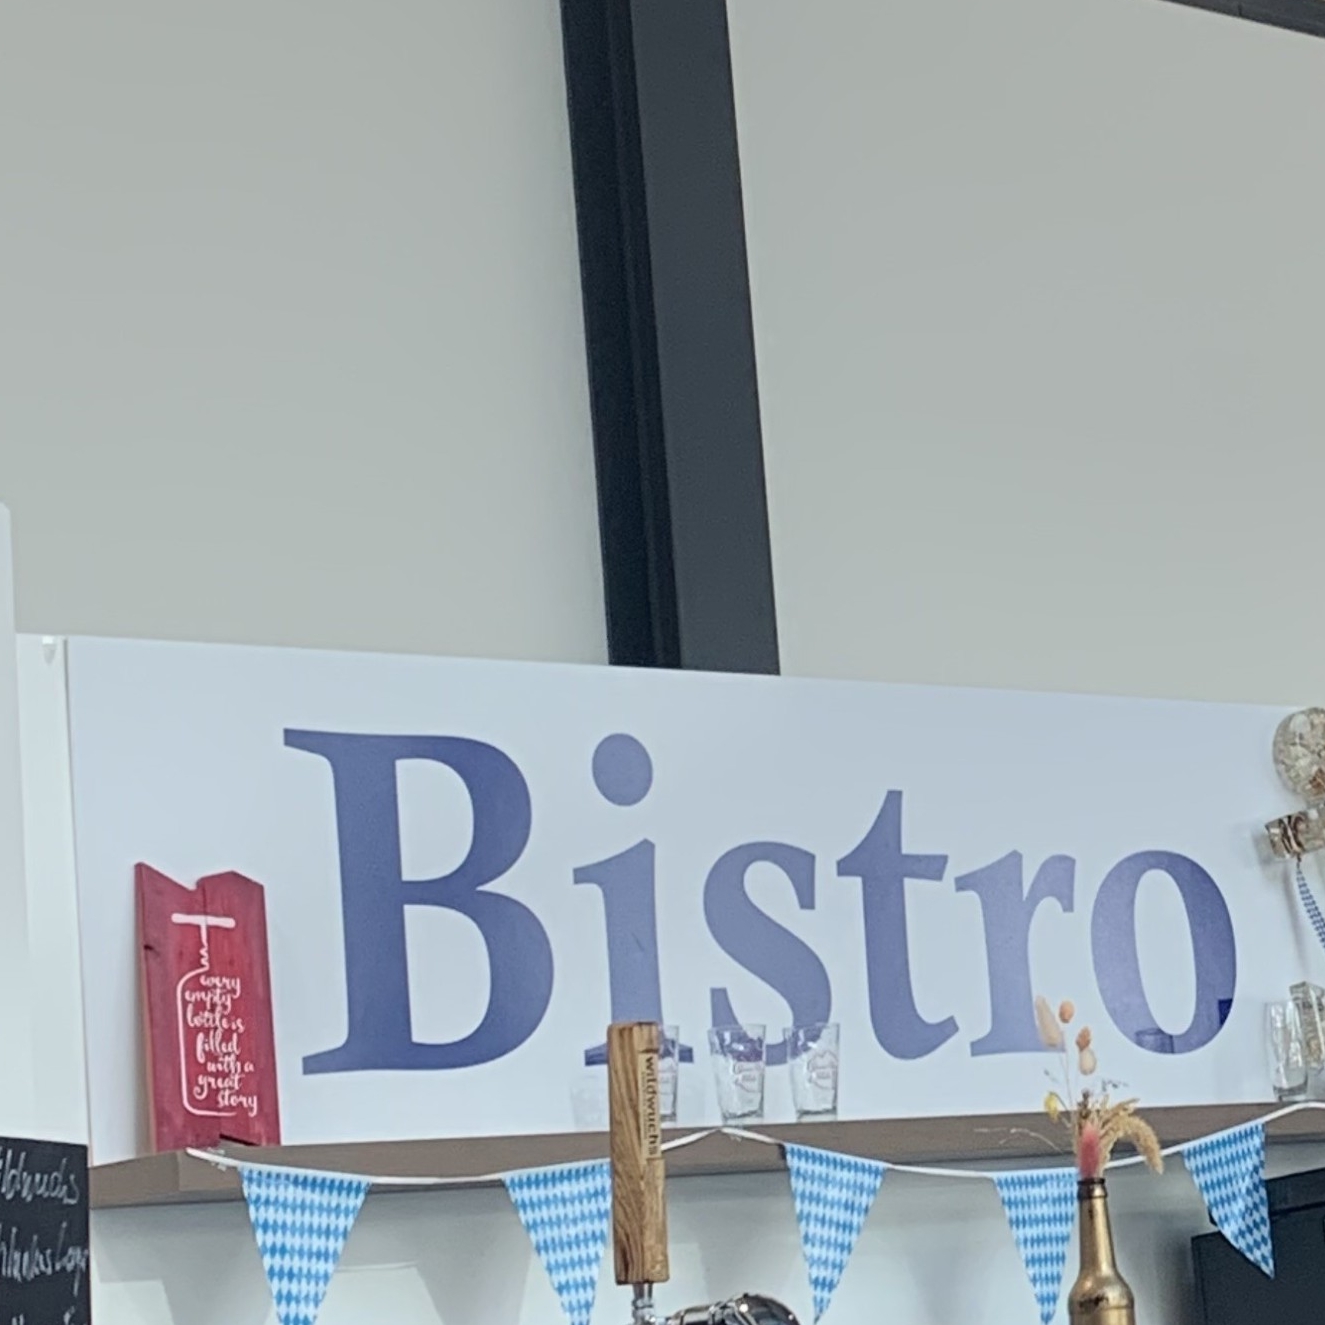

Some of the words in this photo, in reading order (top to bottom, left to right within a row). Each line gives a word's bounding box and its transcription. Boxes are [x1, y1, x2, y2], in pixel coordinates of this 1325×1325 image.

[283, 727, 1238, 1076] Bistro
[184, 987, 232, 1015] empty
[200, 974, 241, 999] every
[186, 1003, 230, 1030] bottle
[230, 1015, 246, 1034] is
[195, 1029, 241, 1064] filled
[206, 1053, 241, 1073] with
[243, 1060, 255, 1072] a
[192, 1073, 246, 1100] great
[217, 1088, 258, 1117] story
[645, 1055, 660, 1156] wildwuchs
